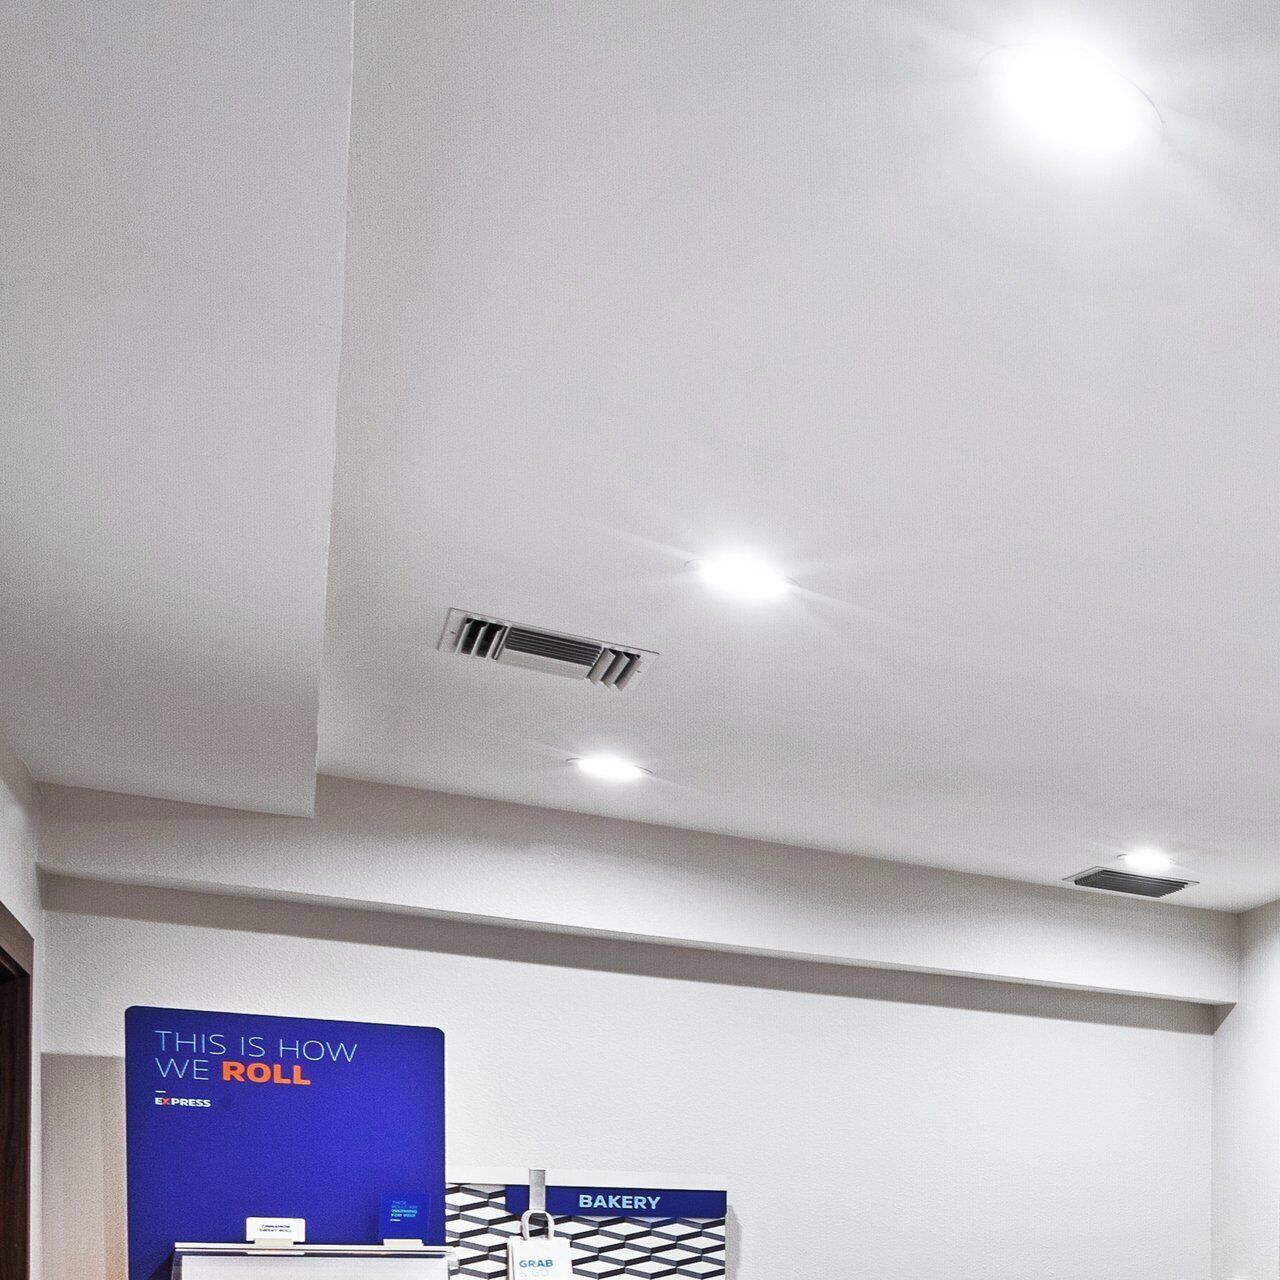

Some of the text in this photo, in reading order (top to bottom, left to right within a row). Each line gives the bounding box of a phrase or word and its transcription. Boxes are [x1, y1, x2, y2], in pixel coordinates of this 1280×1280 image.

[155, 1030, 358, 1063] THIS IS HOW
[155, 1057, 311, 1086] WE ROLL
[154, 1096, 212, 1108] EXPRESS
[579, 1194, 661, 1210] BAKERY
[519, 1259, 554, 1268] GRAB
